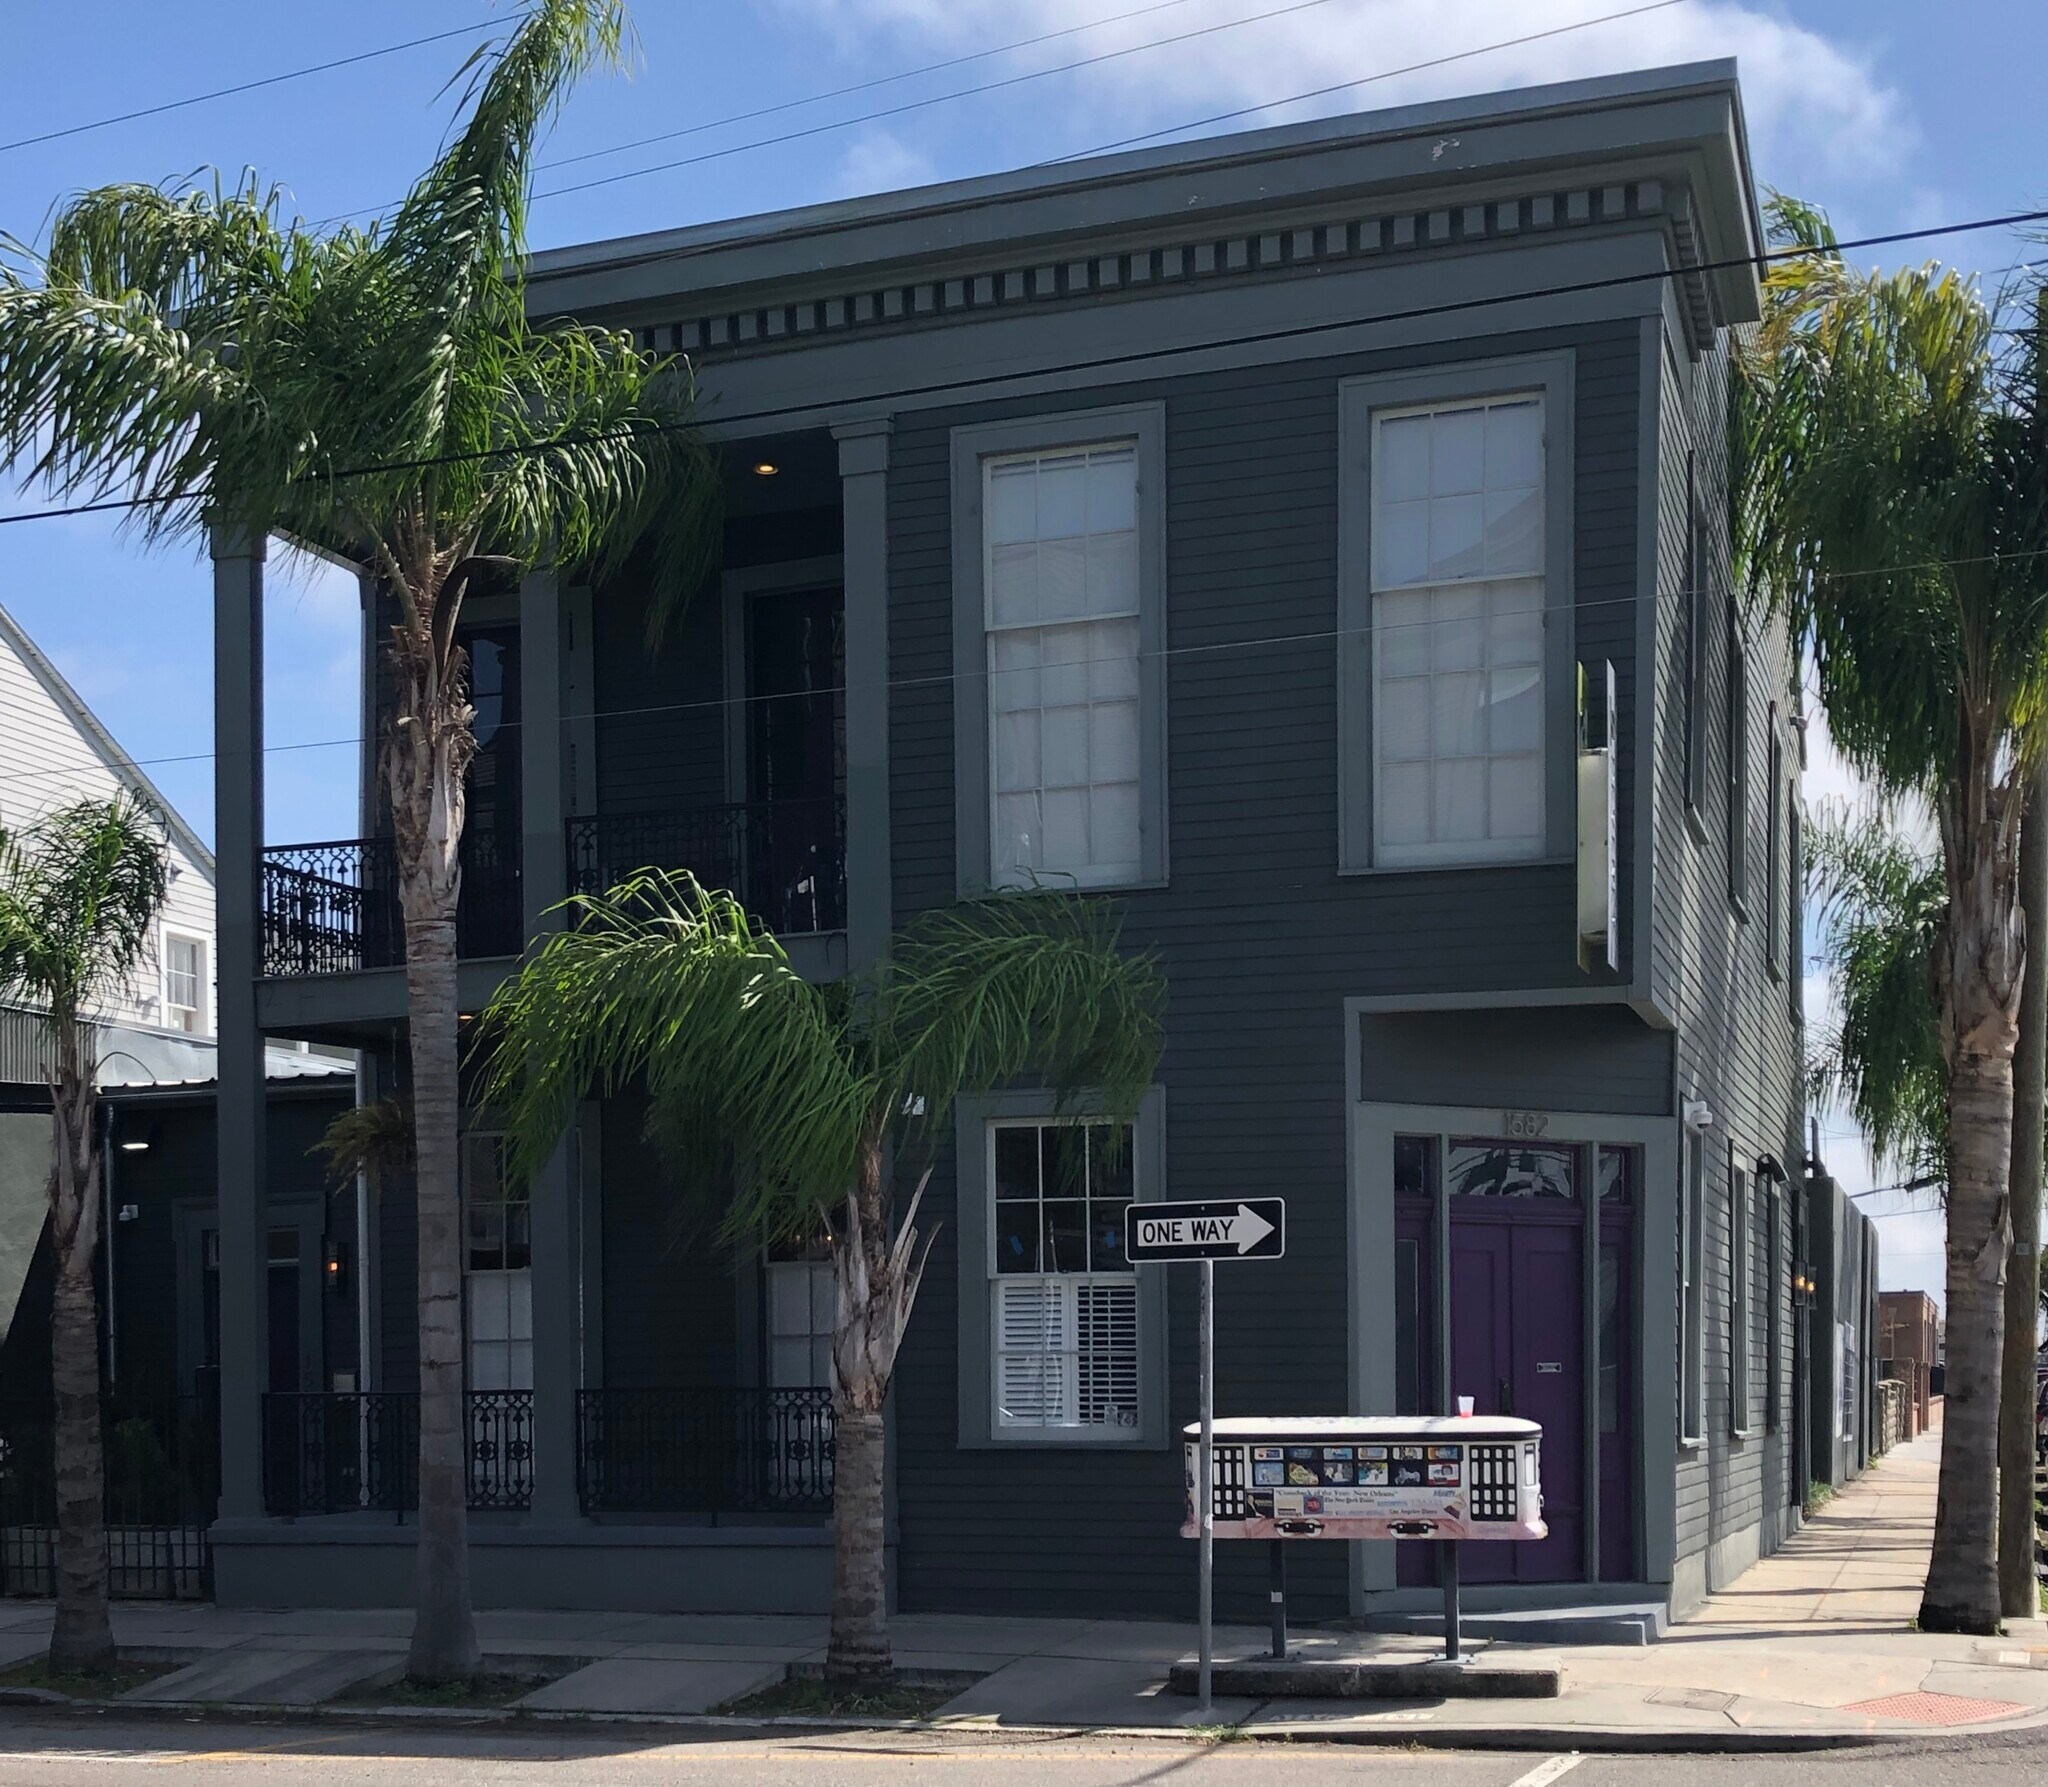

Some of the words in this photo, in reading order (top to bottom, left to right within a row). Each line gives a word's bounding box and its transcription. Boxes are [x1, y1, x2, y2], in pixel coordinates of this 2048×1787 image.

[1504, 1112, 1551, 1137] 1582
[1142, 1221, 1183, 1243] ONE
[1191, 1219, 1235, 1241] WAY
